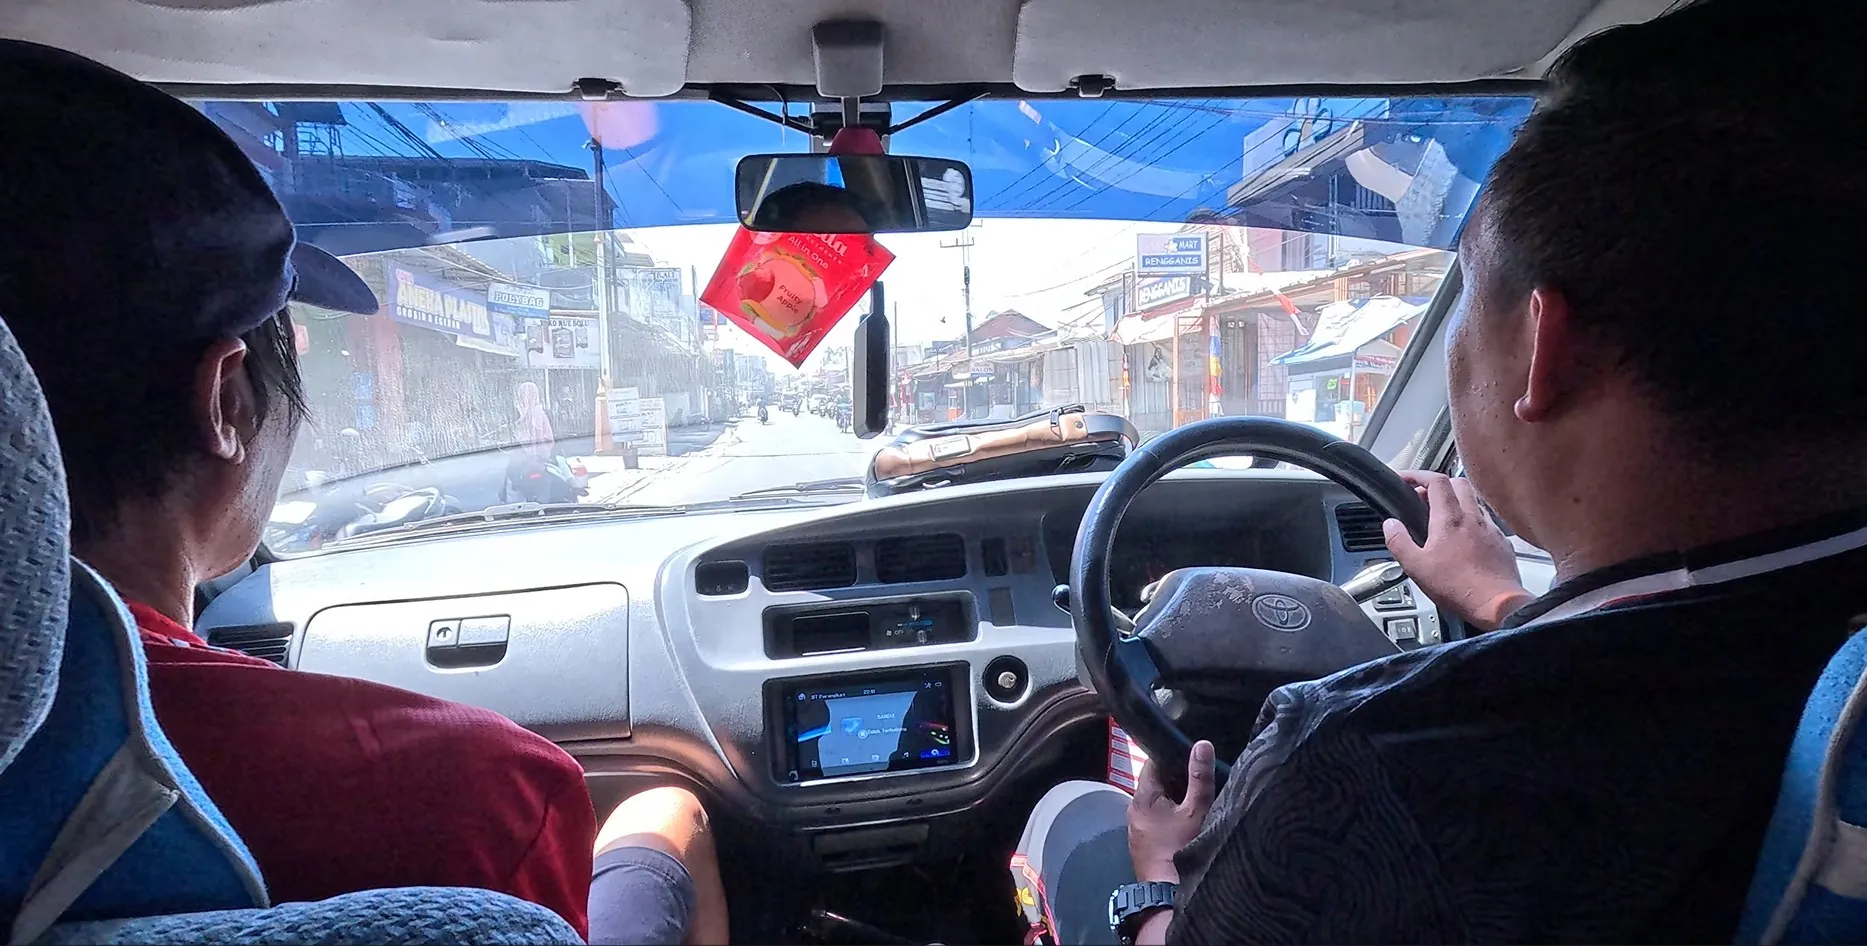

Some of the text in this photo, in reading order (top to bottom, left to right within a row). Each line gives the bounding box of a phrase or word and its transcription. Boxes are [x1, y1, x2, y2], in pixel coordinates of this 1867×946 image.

[788, 236, 801, 249] All
[811, 252, 829, 270] One
[1178, 240, 1198, 249] MART
[1145, 256, 1199, 265] RENGGANIS
[397, 282, 444, 318] ANEKA
[494, 291, 543, 307] POLYBAG
[778, 284, 803, 304] Fruity
[776, 295, 799, 315] Apple
